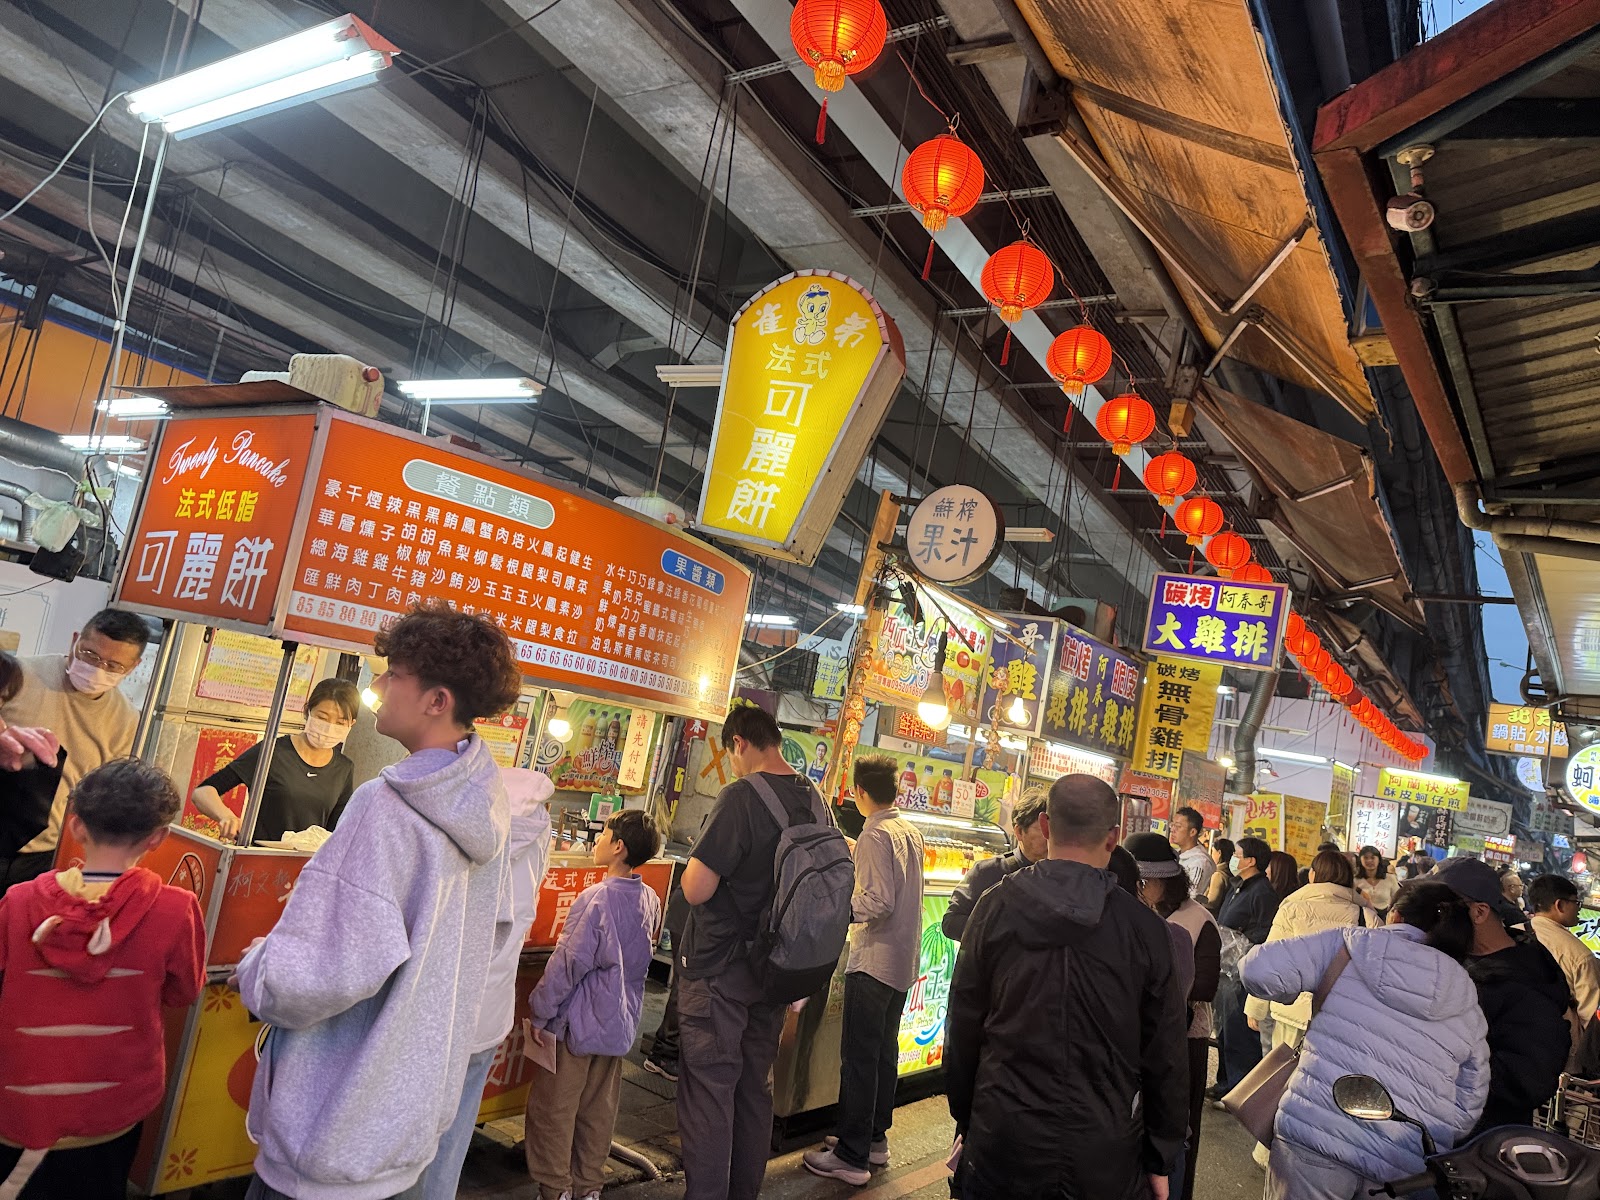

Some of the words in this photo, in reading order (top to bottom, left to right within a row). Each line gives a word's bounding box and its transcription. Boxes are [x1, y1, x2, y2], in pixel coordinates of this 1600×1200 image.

[764, 343, 832, 379] 法式
[223, 430, 291, 488] Pancake
[726, 379, 814, 530] 可麗餅
[175, 488, 259, 523] 法式低脂
[434, 471, 531, 520] 餐點類
[932, 497, 979, 523] 鮮榨
[136, 530, 275, 610] 可麗餅
[368, 495, 403, 600] 辣子雞丁
[386, 500, 422, 605] 黑胡椒牛肉
[915, 523, 979, 567] 果汁
[674, 556, 717, 591] 果醬類
[1163, 580, 1215, 609] 碳烤
[296, 596, 314, 614] 85
[317, 600, 335, 618] 85
[338, 605, 357, 623] 80
[359, 609, 377, 627] 80
[520, 644, 533, 659] 65
[535, 647, 548, 663] 65
[549, 650, 561, 666] 65
[562, 652, 574, 667] 65
[574, 654, 585, 671] 60
[586, 657, 596, 673] 60
[597, 661, 608, 676] 55
[1153, 611, 1271, 662] 大雞排
[1059, 634, 1092, 682] 碳烤
[1111, 659, 1139, 702] 脆皮
[1156, 662, 1202, 682] 碳烤
[624, 713, 649, 783] 請先付款
[1100, 697, 1136, 750] 雞排
[1145, 680, 1193, 774] 無骨雞排
[1131, 784, 1169, 799] 三份130元
[1383, 786, 1461, 810] 酥皮蚵仔煎
[1388, 775, 1459, 796] 阿蘭快炒
